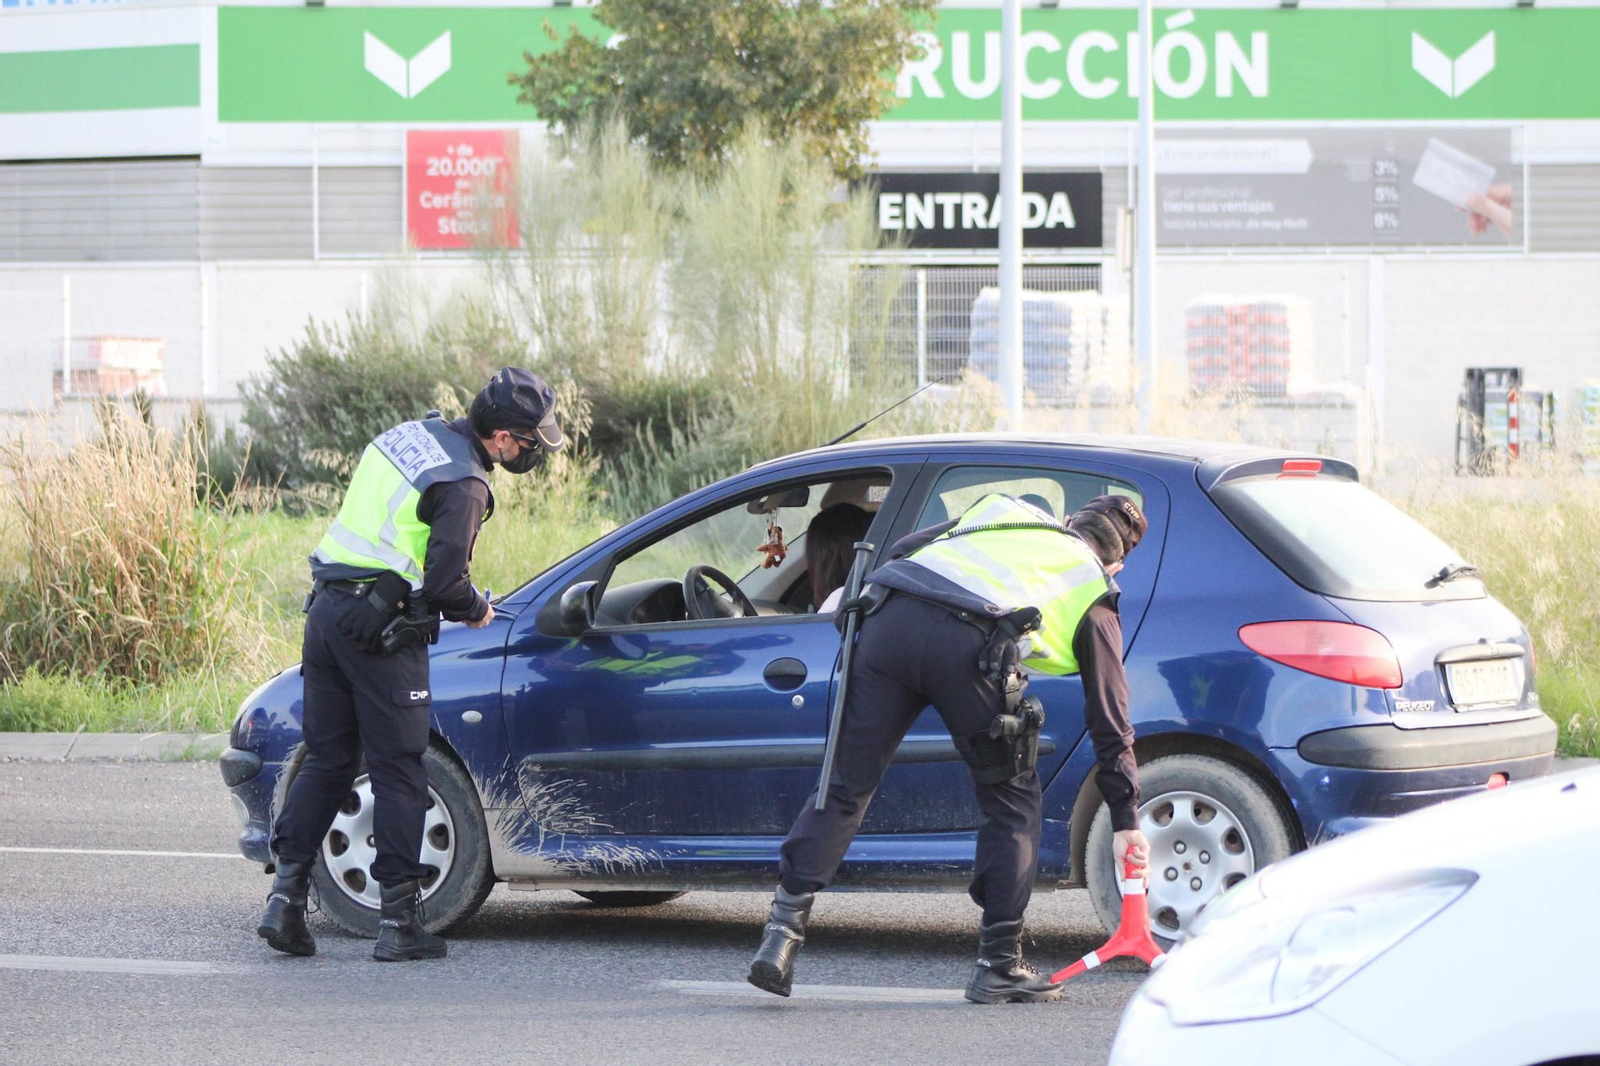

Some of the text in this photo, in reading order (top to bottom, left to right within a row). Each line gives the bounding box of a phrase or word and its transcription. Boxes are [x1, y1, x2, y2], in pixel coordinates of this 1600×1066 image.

[895, 9, 1269, 99] RUCCIÓN
[419, 190, 506, 209] Ceráma
[1197, 201, 1218, 213] sus
[1219, 200, 1275, 215] ventajas
[1124, 502, 1140, 519] CNP
[410, 690, 429, 700] CNP
[1395, 700, 1435, 713] PEUGEOT
